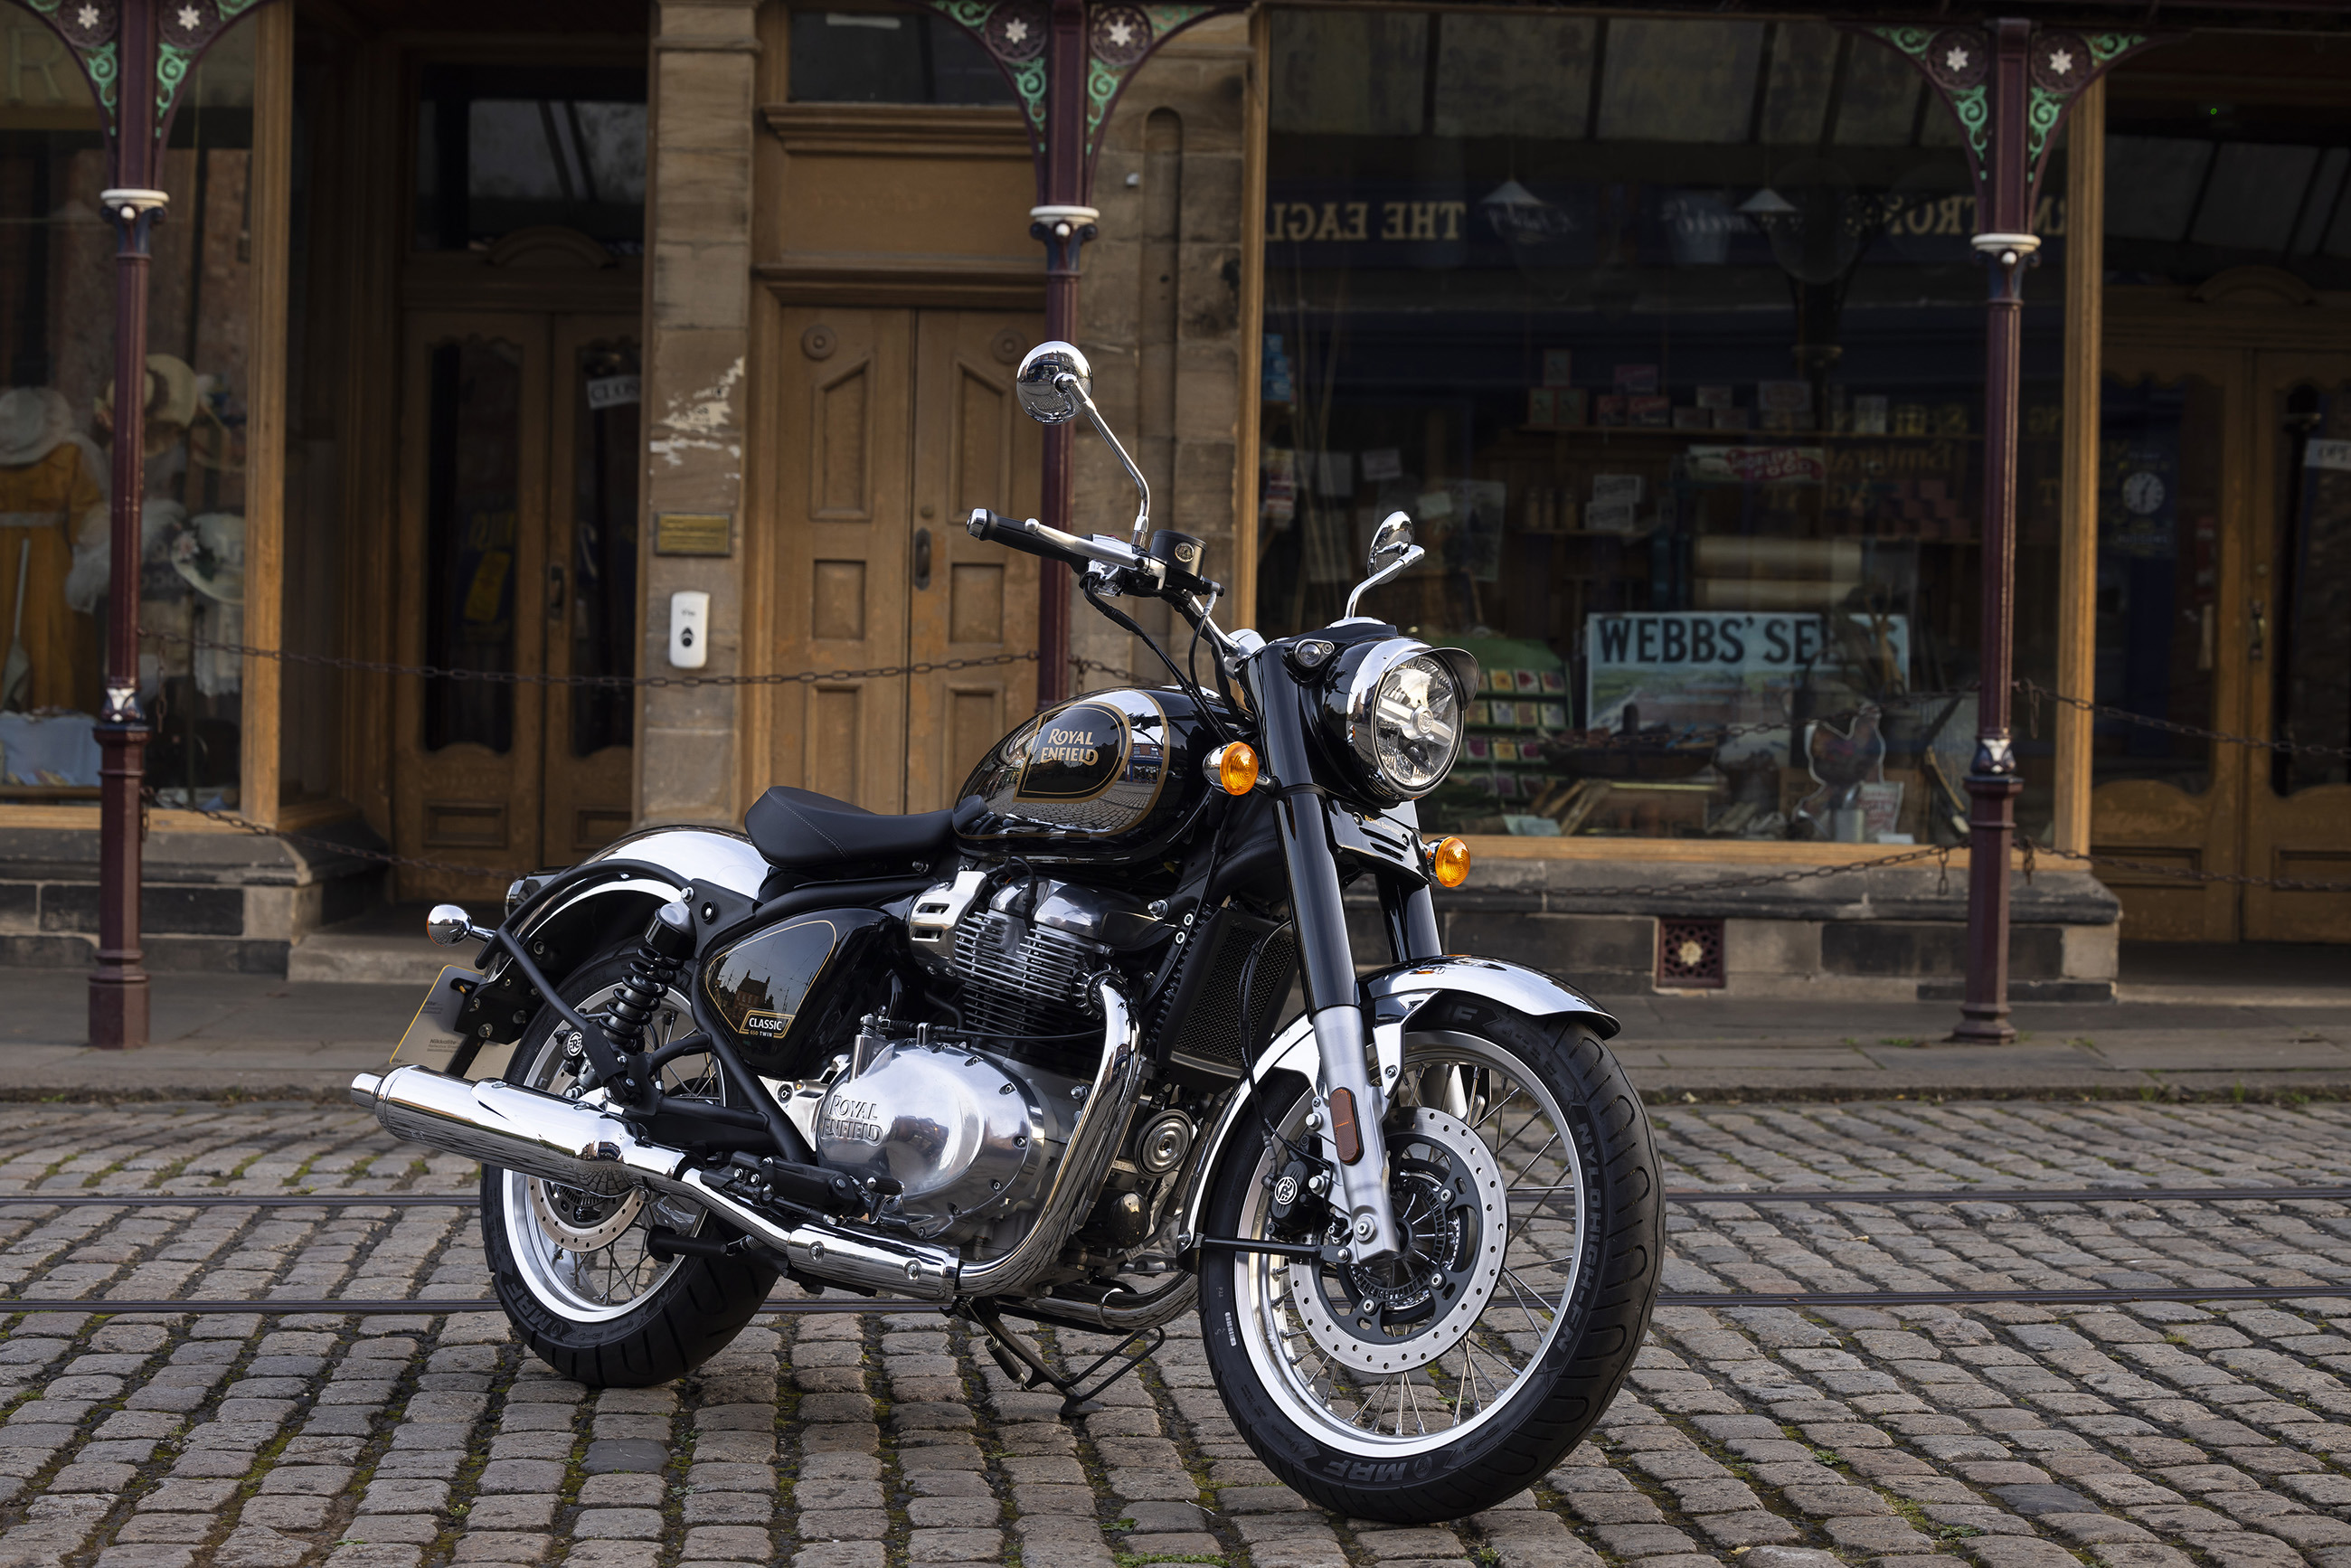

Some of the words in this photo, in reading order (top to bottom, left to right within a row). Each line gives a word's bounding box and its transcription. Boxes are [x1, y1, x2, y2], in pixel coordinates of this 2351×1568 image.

[1754, 459, 1813, 478] FOOD
[1598, 617, 1754, 664] WEBBS'
[1047, 728, 1094, 745] ROYAL
[1040, 747, 1099, 766] ENFIELD
[749, 1017, 782, 1031] CLASSIC
[828, 1095, 878, 1120] ROYAL
[823, 1116, 883, 1143] ENFIELD
[1555, 1121, 1603, 1355] NYLOHIGH-FN
[505, 1282, 552, 1332] MRF
[1322, 1459, 1408, 1483] MRF
